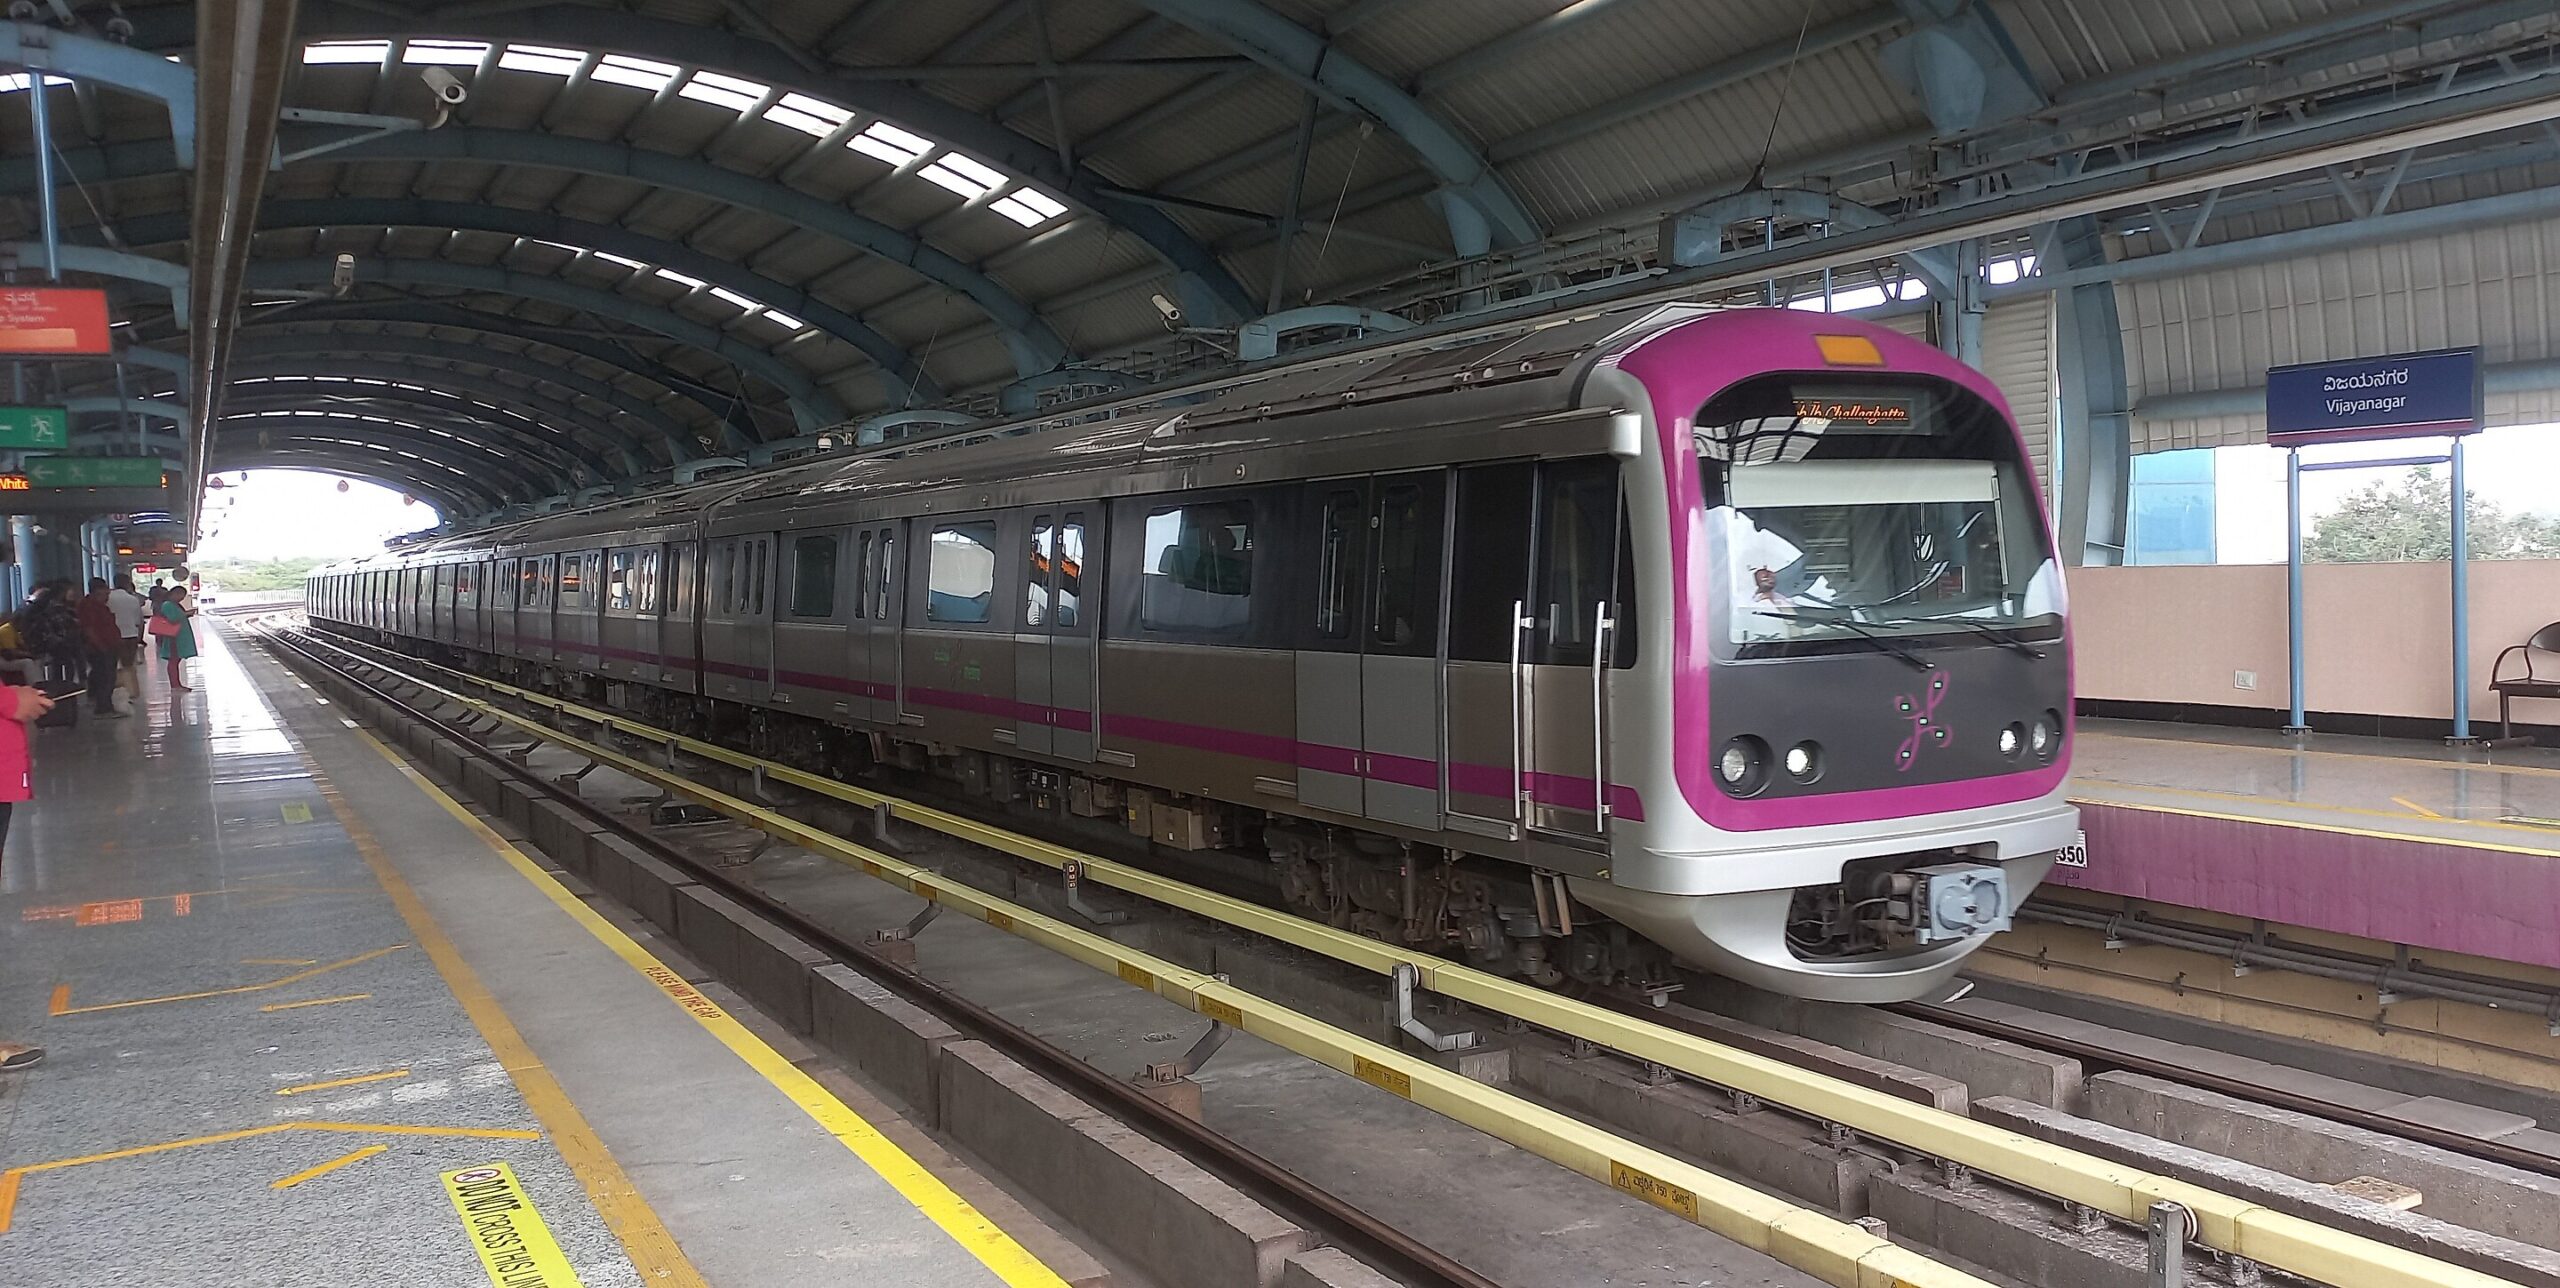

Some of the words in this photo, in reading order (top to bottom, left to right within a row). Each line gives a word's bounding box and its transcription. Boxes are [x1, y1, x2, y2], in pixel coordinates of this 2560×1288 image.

[2323, 368, 2409, 392] ವಿಜಯನಗರ
[2326, 395, 2407, 416] Vijayanagar
[642, 966, 679, 986] PLEASE
[692, 1006, 722, 1019] GAP
[456, 1179, 510, 1197] DO
[463, 1192, 522, 1217] NOT
[473, 1214, 522, 1249] CROSS
[490, 1245, 536, 1273] THIS
